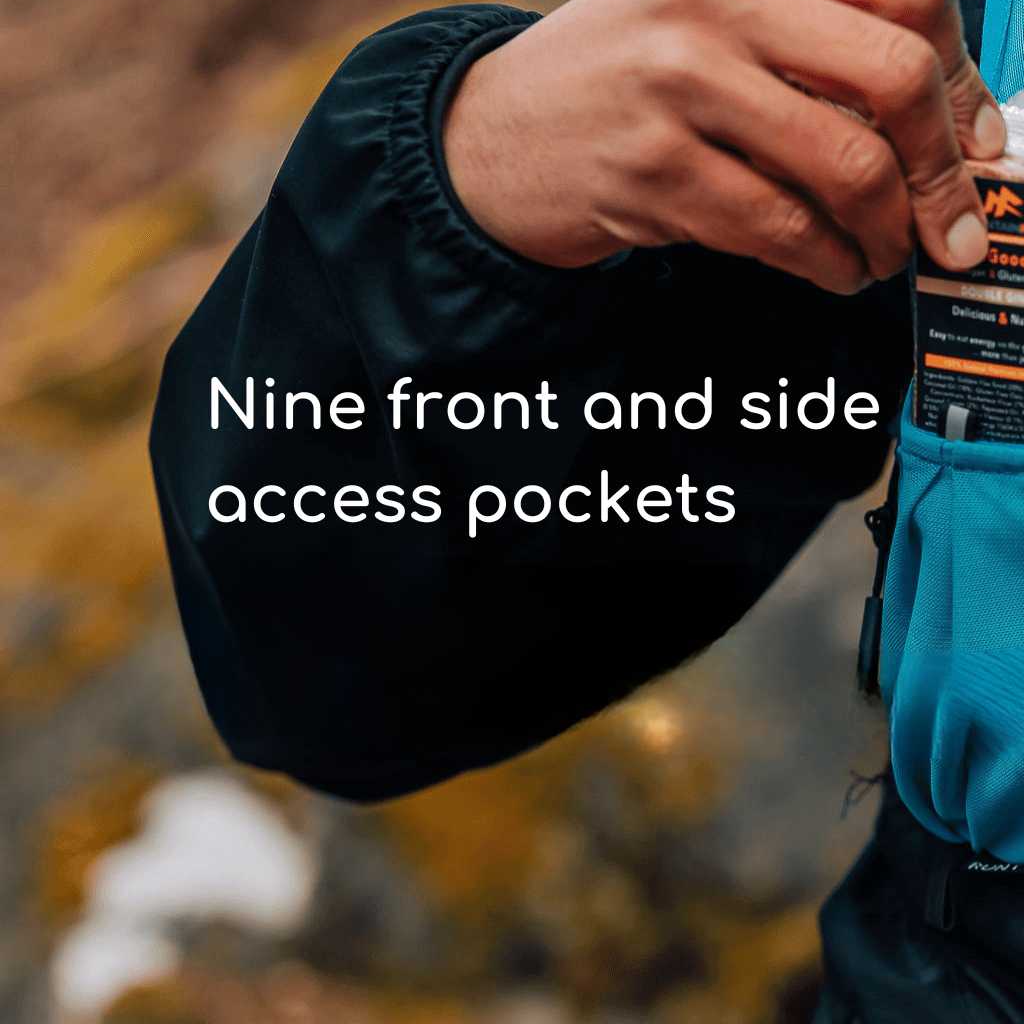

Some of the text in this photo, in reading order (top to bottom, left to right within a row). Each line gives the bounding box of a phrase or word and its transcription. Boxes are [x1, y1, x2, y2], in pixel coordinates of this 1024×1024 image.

[952, 304, 996, 322] Delicious
[998, 311, 1008, 325] &
[929, 328, 946, 340] Easy
[970, 337, 996, 349] energy
